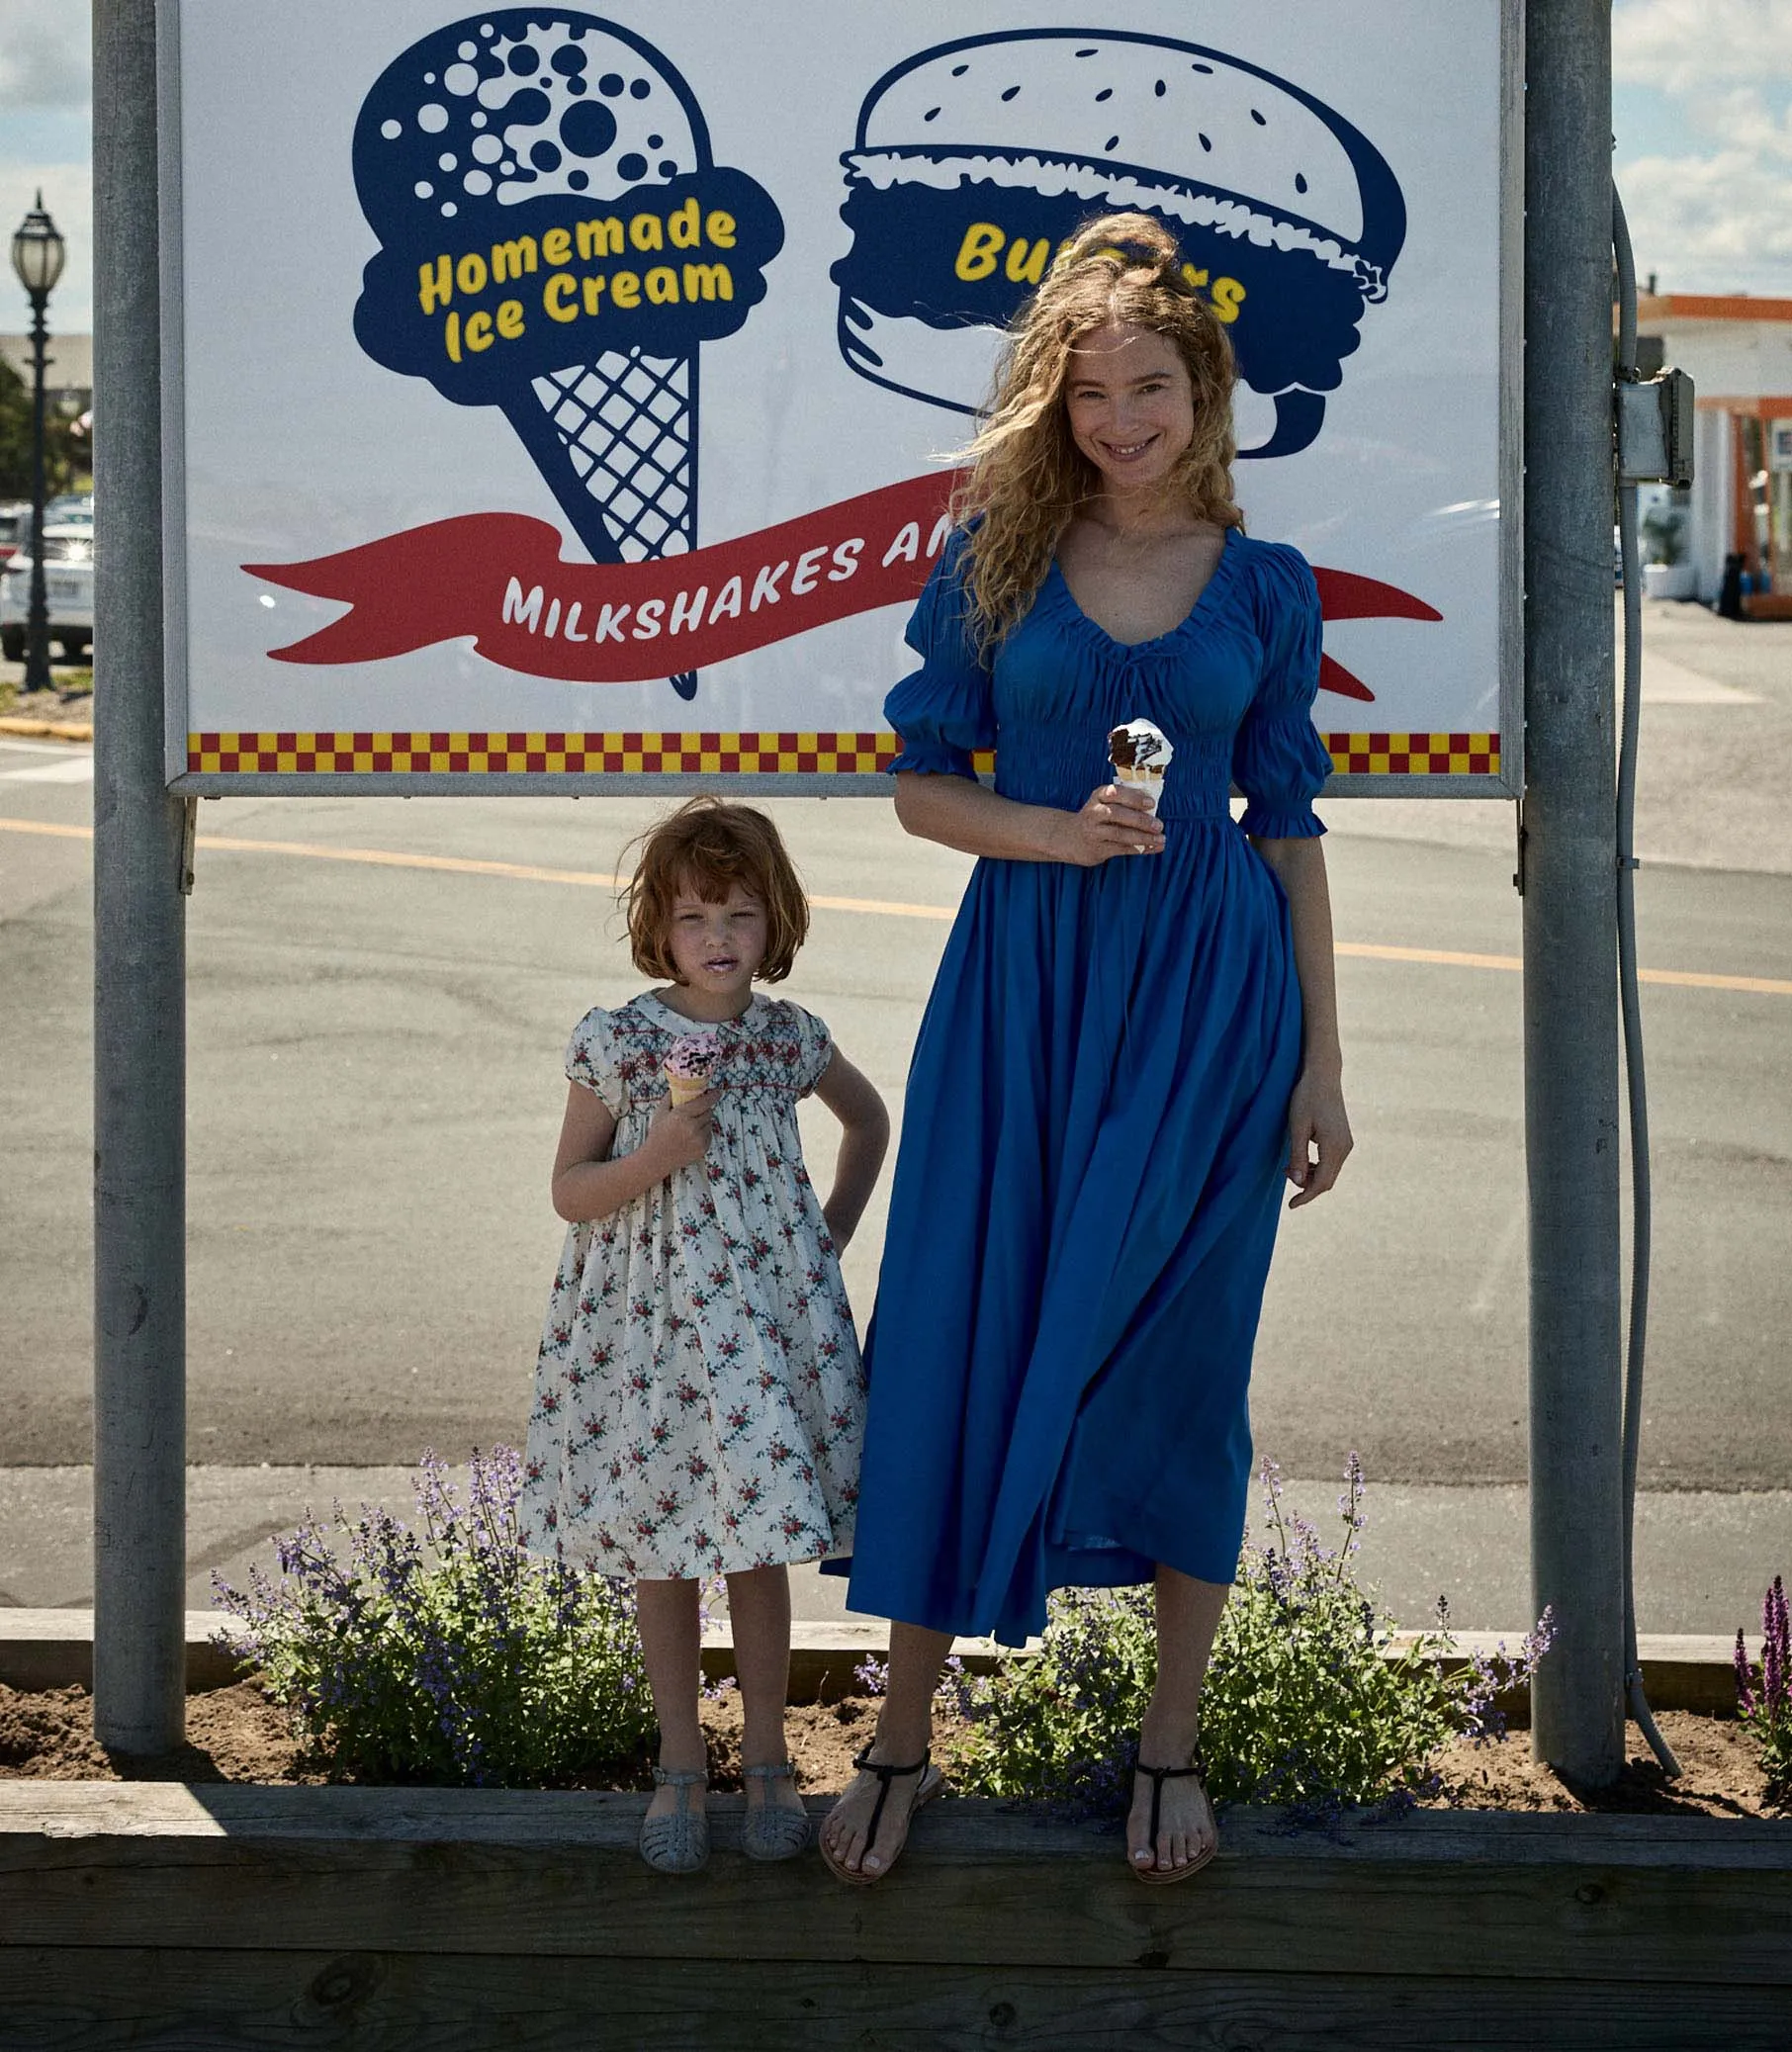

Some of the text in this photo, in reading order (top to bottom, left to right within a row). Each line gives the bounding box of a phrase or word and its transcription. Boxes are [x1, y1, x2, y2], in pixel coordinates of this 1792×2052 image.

[418, 197, 737, 315] Homemade
[954, 222, 1246, 323] Burs
[445, 262, 734, 363] Ice Cream
[501, 537, 865, 644] MILKSHAKES
